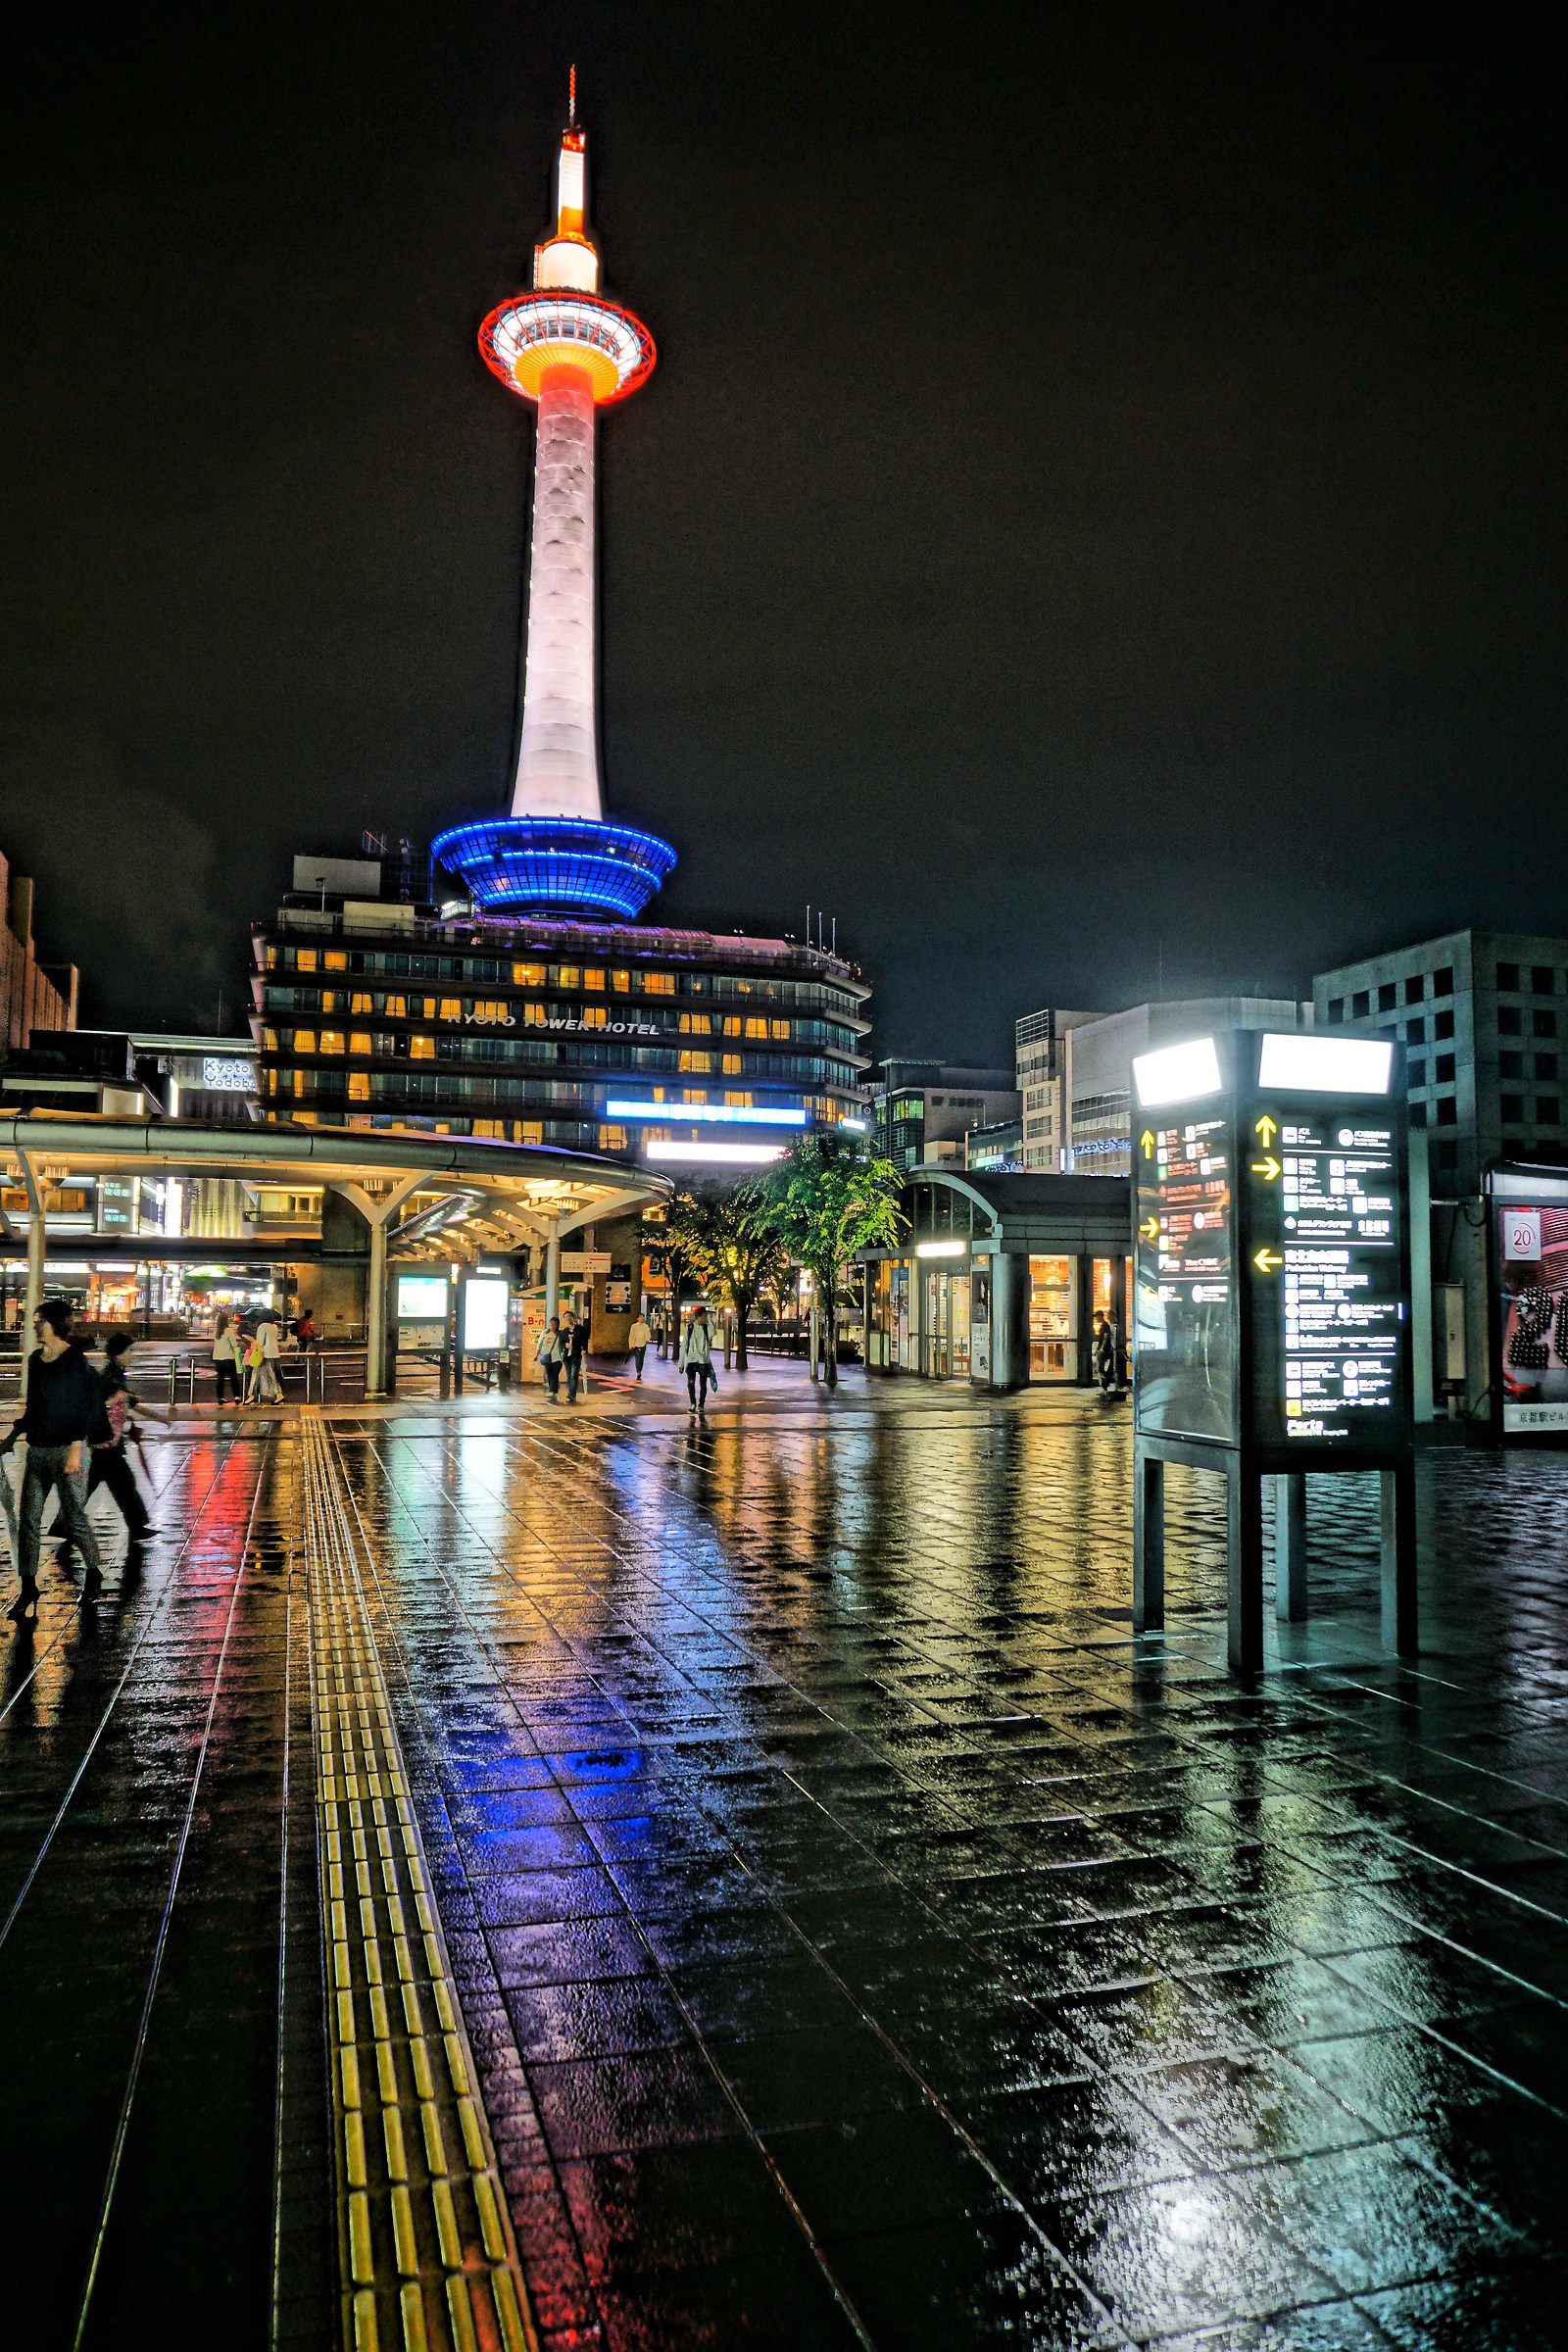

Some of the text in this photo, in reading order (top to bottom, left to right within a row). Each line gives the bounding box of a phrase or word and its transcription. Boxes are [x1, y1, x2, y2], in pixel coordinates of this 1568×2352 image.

[447, 1012, 660, 1036] KYOTO TOWER HOTEL
[204, 1059, 250, 1074] Kyoto
[1513, 1229, 1532, 1247] 20
